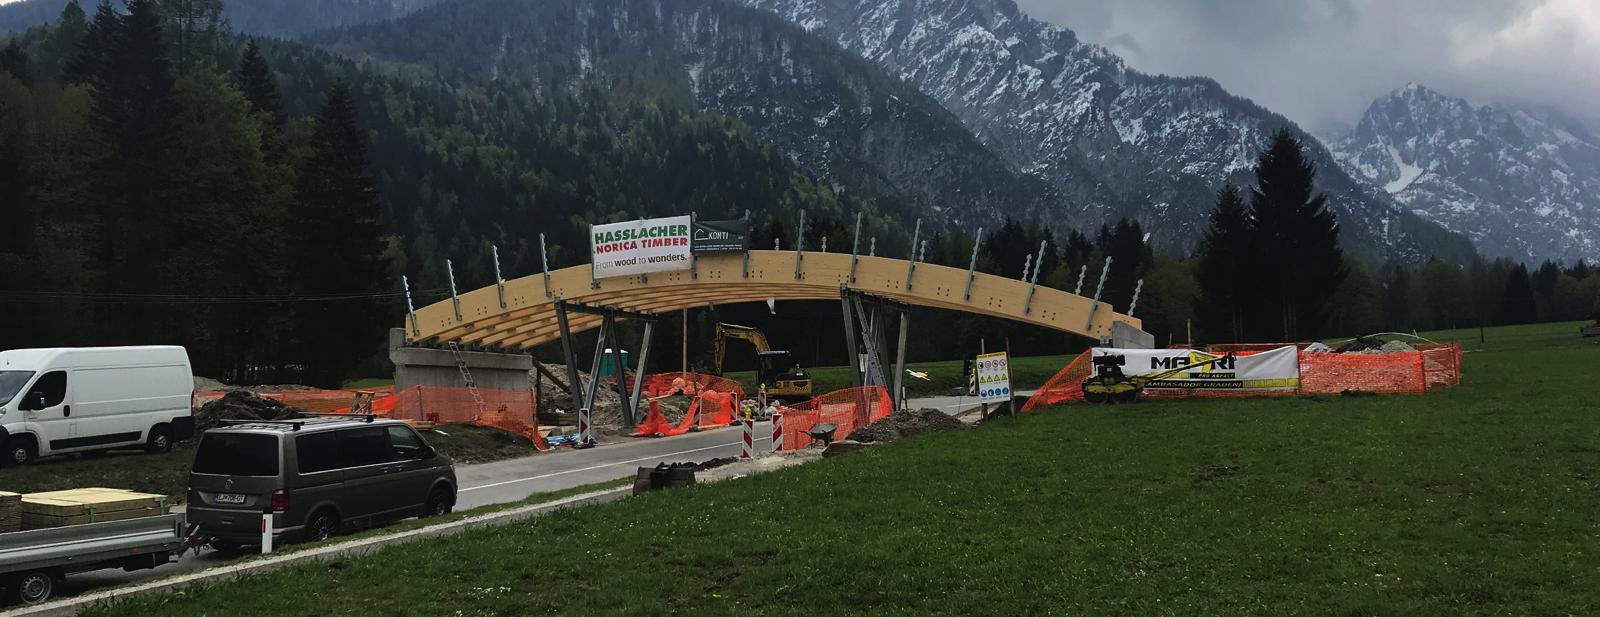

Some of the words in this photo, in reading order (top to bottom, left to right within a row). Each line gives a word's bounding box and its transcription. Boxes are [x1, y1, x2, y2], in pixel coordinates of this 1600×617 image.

[594, 225, 688, 244] HASSLACHER
[708, 231, 729, 240] KONTI
[596, 241, 638, 254] NORICA
[641, 238, 688, 249] TIMBER
[595, 261, 614, 270] From
[614, 257, 637, 267] wood
[638, 257, 647, 265] to
[648, 253, 688, 264] wonders.
